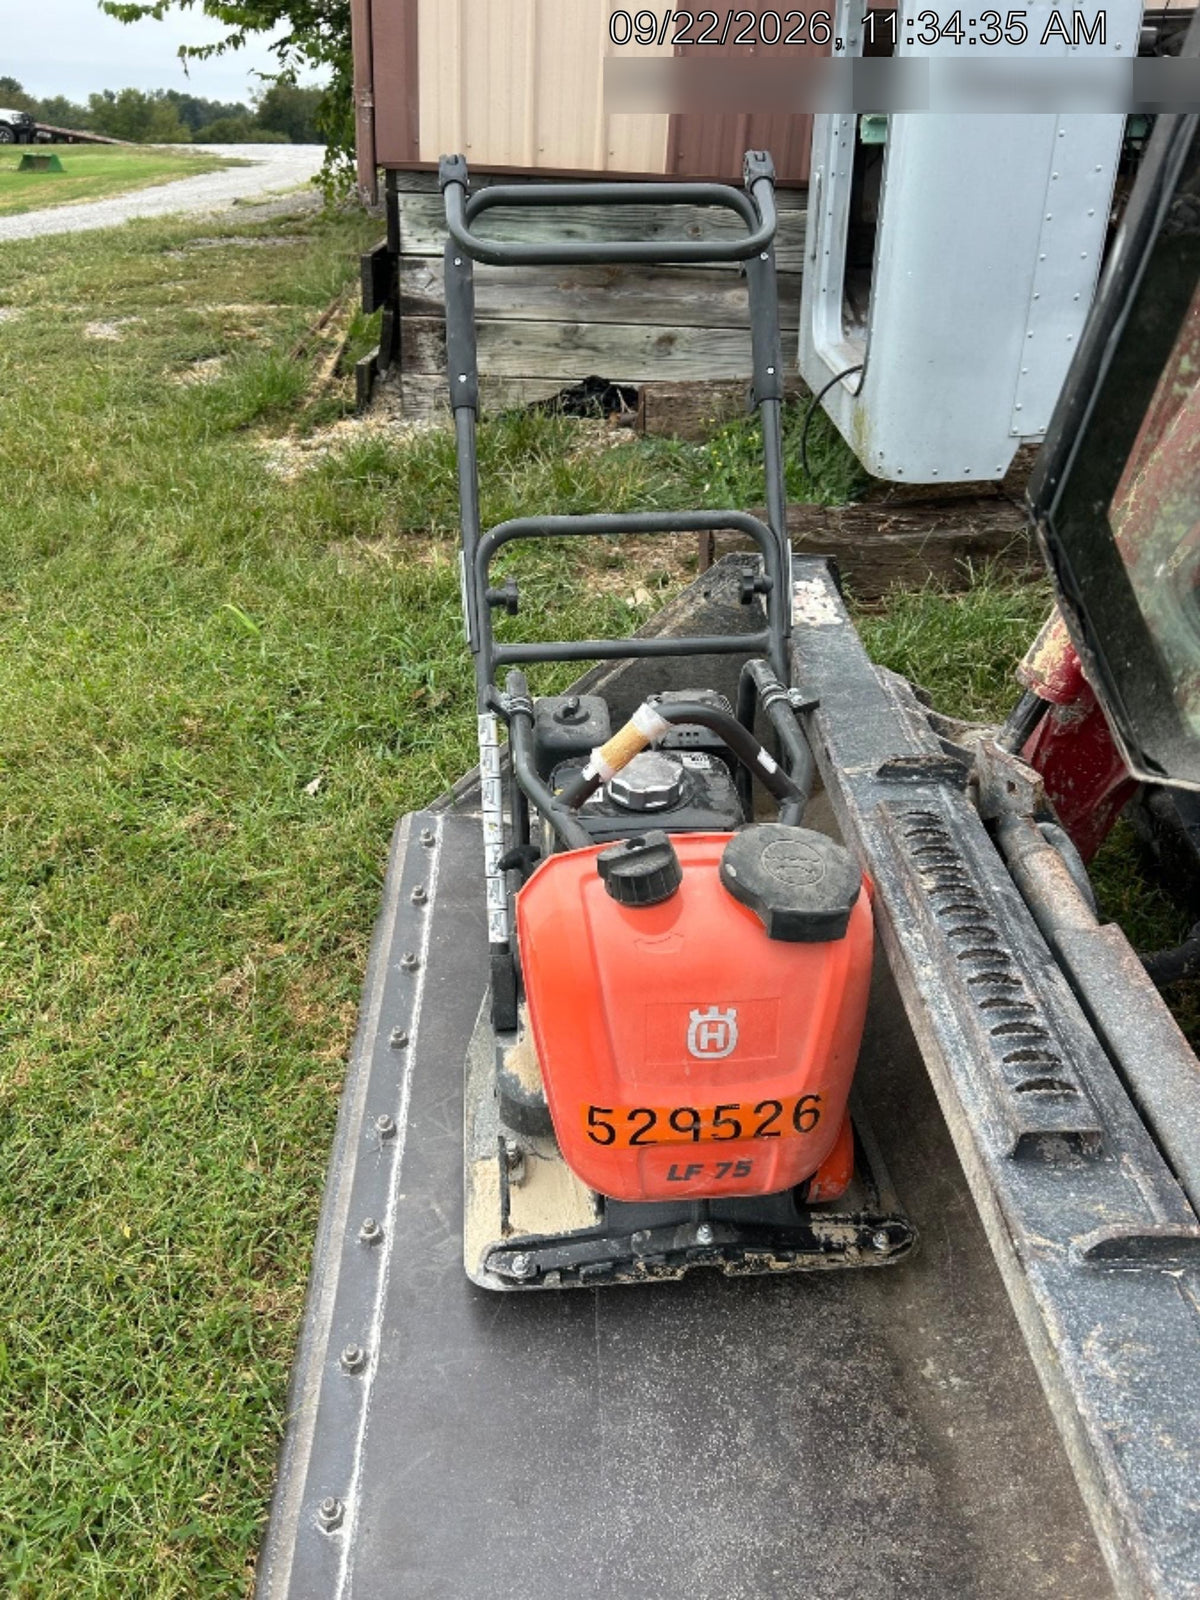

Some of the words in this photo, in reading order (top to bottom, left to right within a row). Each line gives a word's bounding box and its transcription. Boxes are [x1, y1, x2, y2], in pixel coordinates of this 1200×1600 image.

[586, 1094, 822, 1146] 529526
[666, 1163, 704, 1181] LF
[714, 1160, 754, 1179] 75
